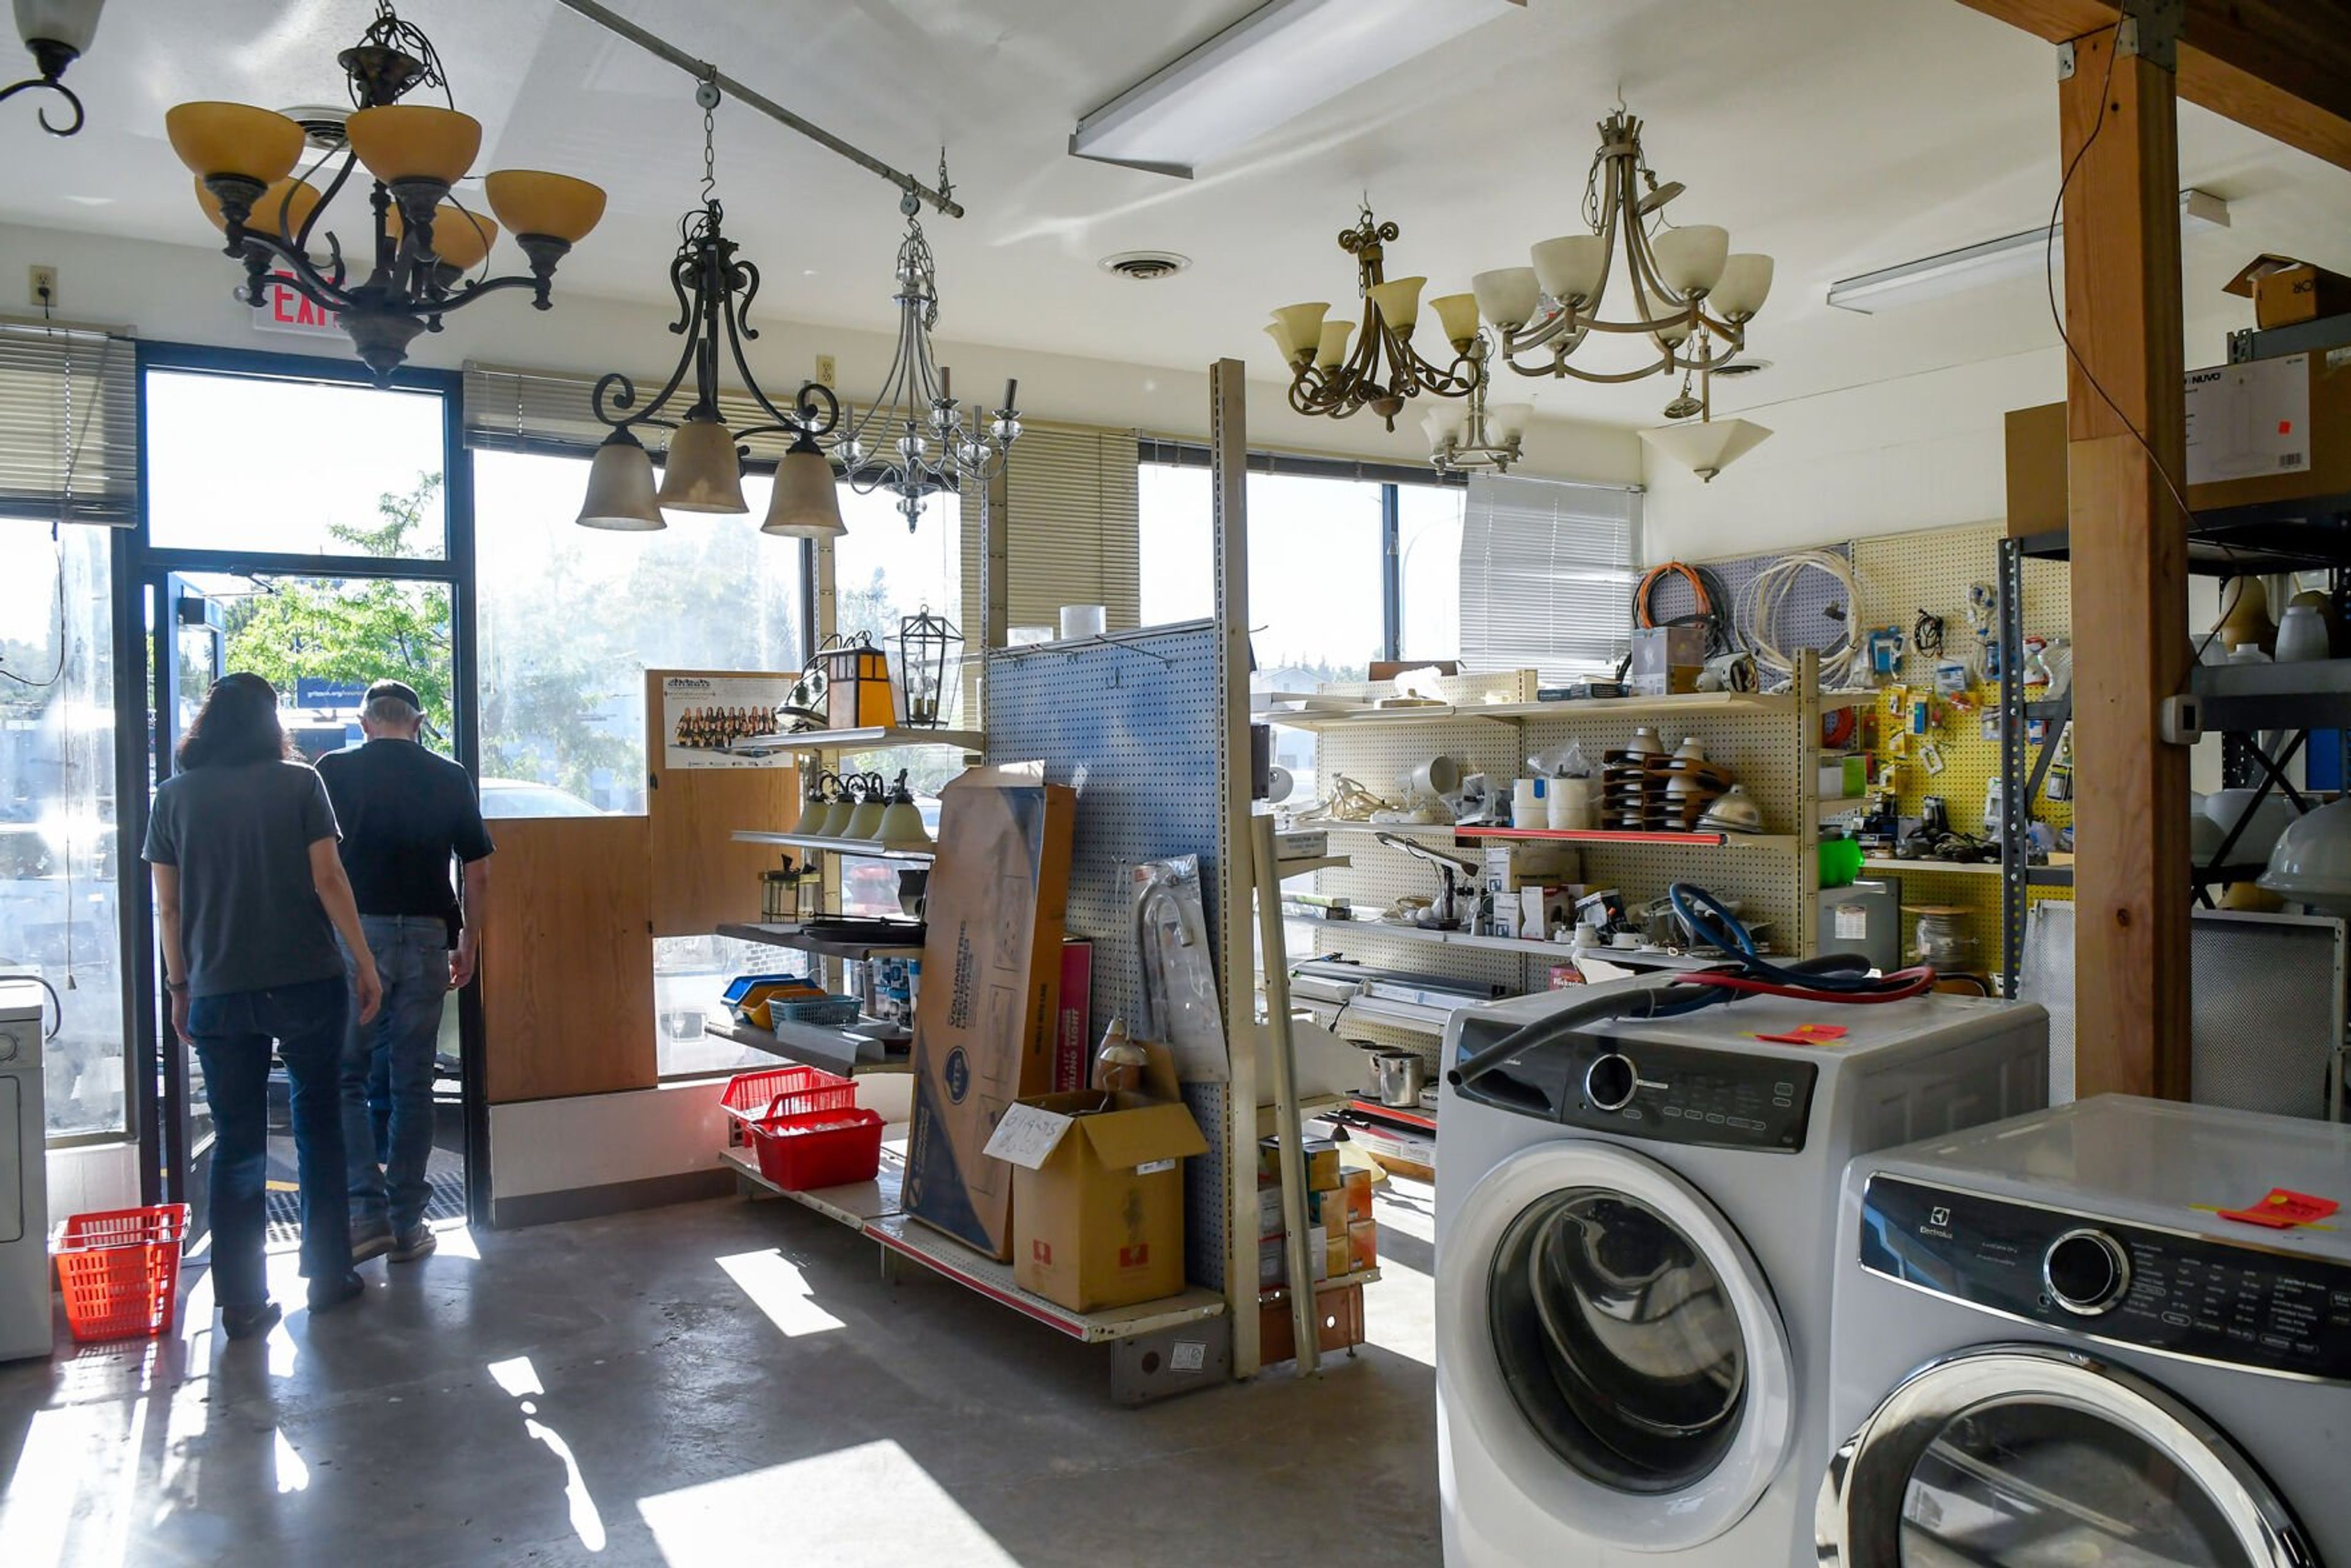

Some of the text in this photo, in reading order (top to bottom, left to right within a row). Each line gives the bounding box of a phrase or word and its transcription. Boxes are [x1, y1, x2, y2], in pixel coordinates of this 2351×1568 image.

[2192, 372, 2222, 386] NUVO
[948, 920, 966, 1026] VOLUMETRIC
[955, 939, 969, 1028] RECESSED
[1920, 1225, 1953, 1239] Electrolux
